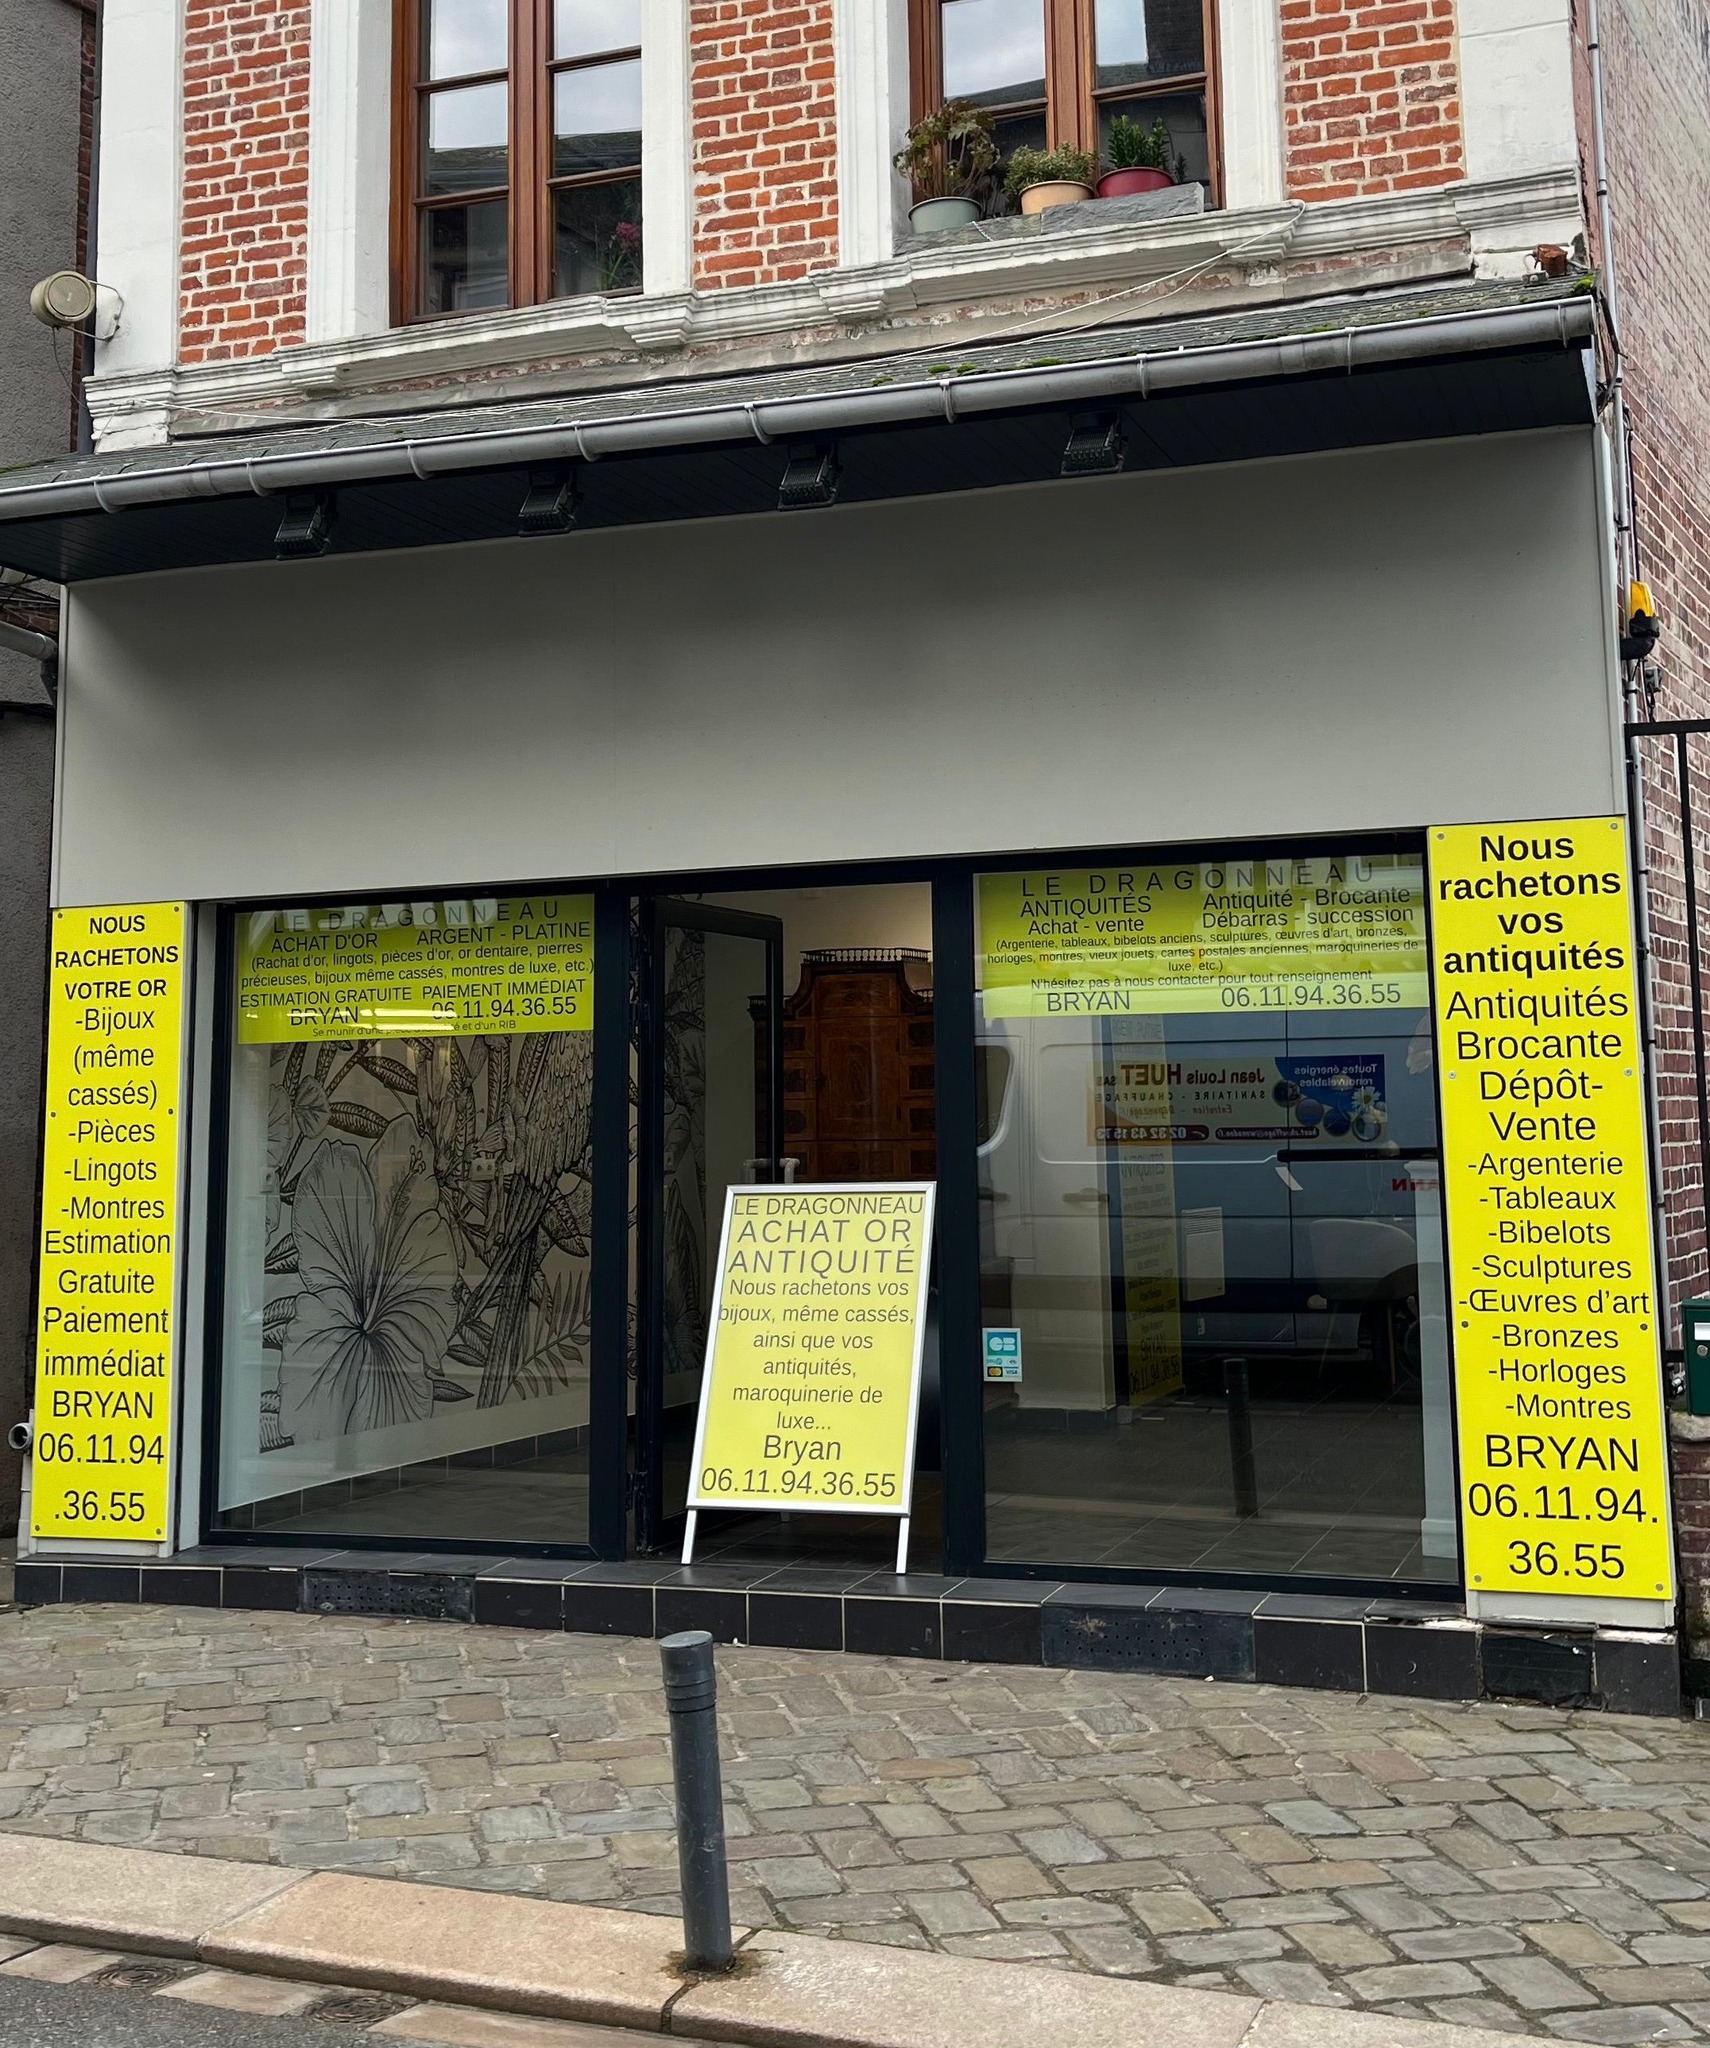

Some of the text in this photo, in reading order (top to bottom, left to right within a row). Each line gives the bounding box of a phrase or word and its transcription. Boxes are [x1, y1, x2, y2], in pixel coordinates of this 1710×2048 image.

[1480, 836, 1575, 862] Nous
[1023, 862, 1372, 896] LE DRAGONNEAU
[1439, 870, 1621, 901] rachetons
[1020, 892, 1151, 919] ANTIQUITÉS
[1203, 889, 1292, 912] Antiquité
[1315, 886, 1410, 906] Brocante
[89, 915, 145, 935] NOUS
[274, 901, 558, 933] LE DRAGONNEAU
[1028, 920, 1078, 935] Achat
[1096, 918, 1144, 932] vente
[1203, 912, 1288, 928] Débarras
[1308, 906, 1413, 924] succession
[1498, 912, 1563, 935] vos
[272, 933, 377, 952] ACHAT D'OR
[417, 927, 494, 945] ARGENT
[513, 922, 590, 940] PLATINE
[996, 939, 1058, 952] (Argenterie,
[1062, 937, 1109, 947] tableaux,
[1114, 935, 1156, 946] bibelots
[1160, 934, 1206, 944] anciens,
[1210, 931, 1270, 943] sculptures,
[1323, 928, 1352, 938] d'art,
[1356, 926, 1406, 937] bronzes,
[55, 945, 179, 968] RACHETONS
[252, 943, 583, 972] (Rachat d'or, lingots, pièces d'or, or dentaire, pierres
[988, 939, 1418, 965] horloges, montres, vieux jouets, cartes postales anciennes, maroquineries de
[1443, 941, 1625, 979] antiquités
[242, 958, 594, 989] précieuses, bijoux même cassés, montres de luxe, etc.)
[1169, 960, 1223, 972] luxe, etc.)
[65, 980, 167, 1000] VOTRE OR
[1032, 970, 1373, 989] N'hésitez pas à nous contacter pour tout renseignement
[241, 978, 585, 1008] ESTIMATION GRATUITE PAIEMENT IMMÉDIAT
[1047, 983, 1400, 1012] BRYAN 06.11.94.36.55
[1445, 986, 1628, 1026] Antiquités
[75, 1007, 155, 1036] -Bijoux
[291, 996, 576, 1025] BRYAN 06.11.94.36.55
[313, 1028, 324, 1037] Se
[327, 1027, 354, 1036] munir
[462, 1022, 472, 1030] et
[475, 1021, 496, 1029] d'un
[500, 1020, 516, 1028] RIB
[1457, 1030, 1622, 1060] Brocante
[73, 1044, 154, 1074] (même
[68, 1080, 157, 1110] cassés)
[1480, 1069, 1603, 1108] Dépôt-
[68, 1120, 155, 1144] -Pièces
[1489, 1112, 1596, 1141] Vente
[64, 1158, 157, 1187] -Lingots
[1468, 1152, 1623, 1181] -Argenterie
[61, 1196, 165, 1219] -Montres
[733, 1197, 924, 1216] LE DRAGONNEAU
[1479, 1186, 1616, 1210] -Tableaux
[44, 1229, 171, 1254] Estimation
[737, 1219, 912, 1243] ACHAT OR
[1488, 1220, 1610, 1244] -Bibelots
[728, 1244, 915, 1279] ANTIQUITÉ
[1472, 1255, 1632, 1284] -Sculptures
[59, 1269, 155, 1294] Gratuite
[729, 1279, 909, 1296] Nous rachetons vos
[719, 1303, 914, 1324] bijoux, même cassés,
[1459, 1290, 1577, 1313] -Œuvres
[44, 1306, 169, 1333] Paiement
[753, 1331, 873, 1352] ainsi que vos
[1492, 1324, 1618, 1348] -Bronzes
[44, 1349, 165, 1377] immédiat
[763, 1359, 856, 1379] antiquités,
[1488, 1359, 1626, 1389] -Horloges
[52, 1391, 153, 1419] BRYAN
[733, 1386, 882, 1406] maroquinerie de
[1505, 1394, 1631, 1420] -Montres
[777, 1412, 831, 1430] luxe...
[39, 1433, 164, 1464] 06.11.94
[763, 1435, 841, 1465] Bryan
[1486, 1434, 1639, 1471] BRYAN
[701, 1468, 896, 1497] 06.11.94.36.55
[55, 1490, 145, 1522] .36.55
[1468, 1483, 1658, 1523] 06.11.94.
[1508, 1540, 1625, 1579] 36.55
